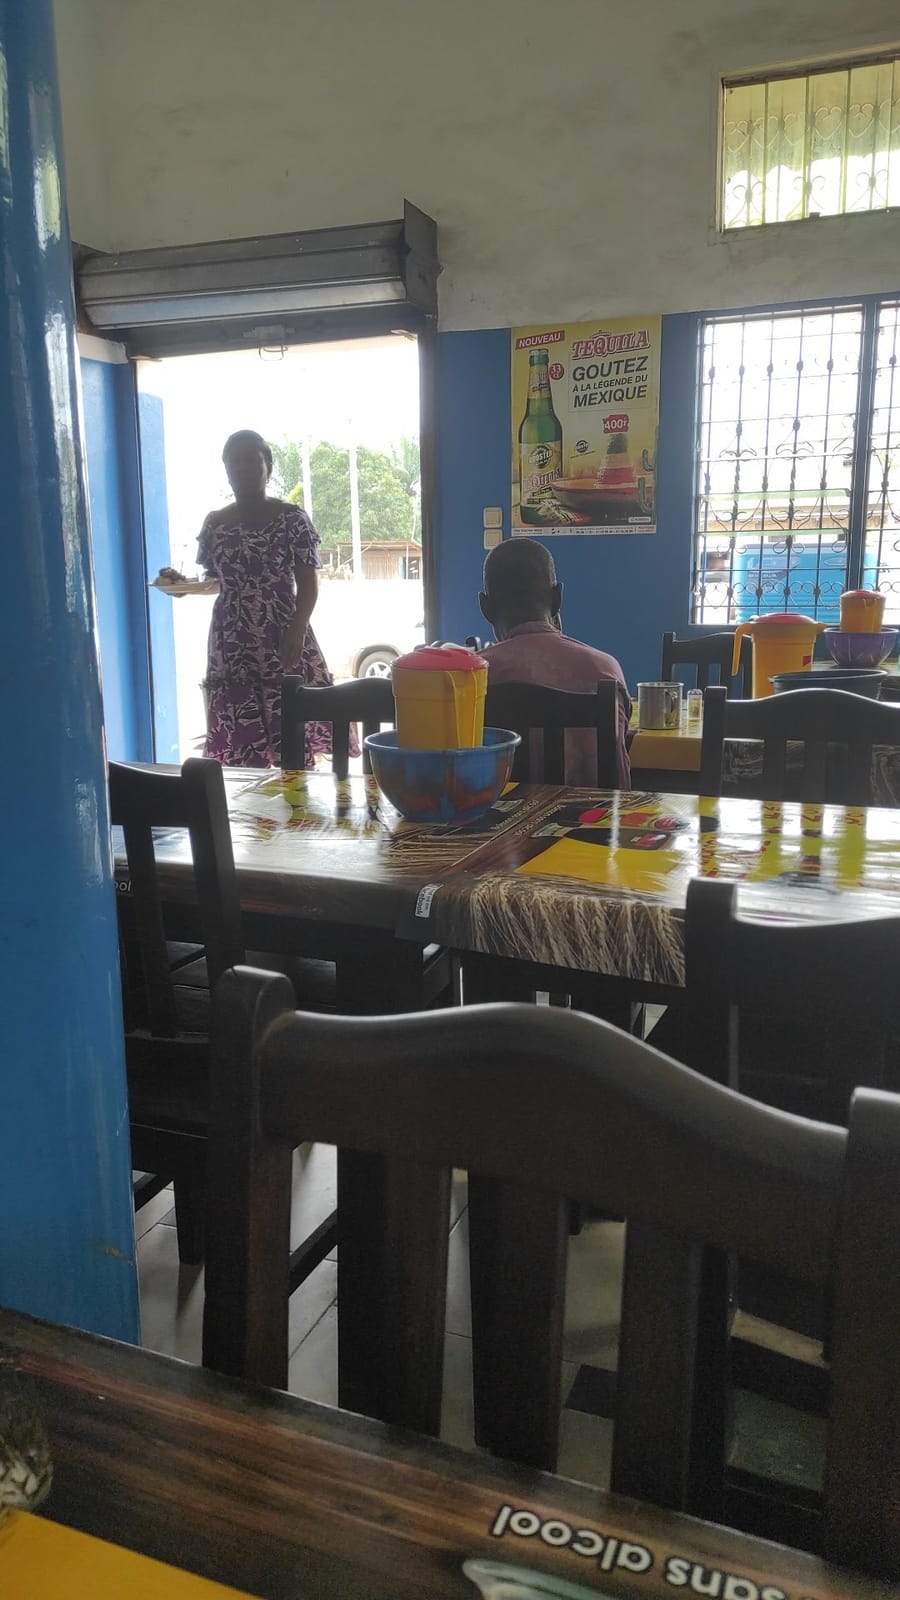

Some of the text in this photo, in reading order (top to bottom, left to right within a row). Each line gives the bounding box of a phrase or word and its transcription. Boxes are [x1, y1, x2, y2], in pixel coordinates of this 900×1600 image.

[518, 332, 561, 348] NOUVEAU
[572, 330, 650, 360] TEQUILA
[572, 355, 649, 381] GOUTEZ
[580, 384, 592, 392] LA
[593, 376, 633, 390] LÉGENDE
[635, 374, 648, 382] DU
[573, 385, 648, 408] MEXIQUE
[492, 1505, 652, 1571] alcool
